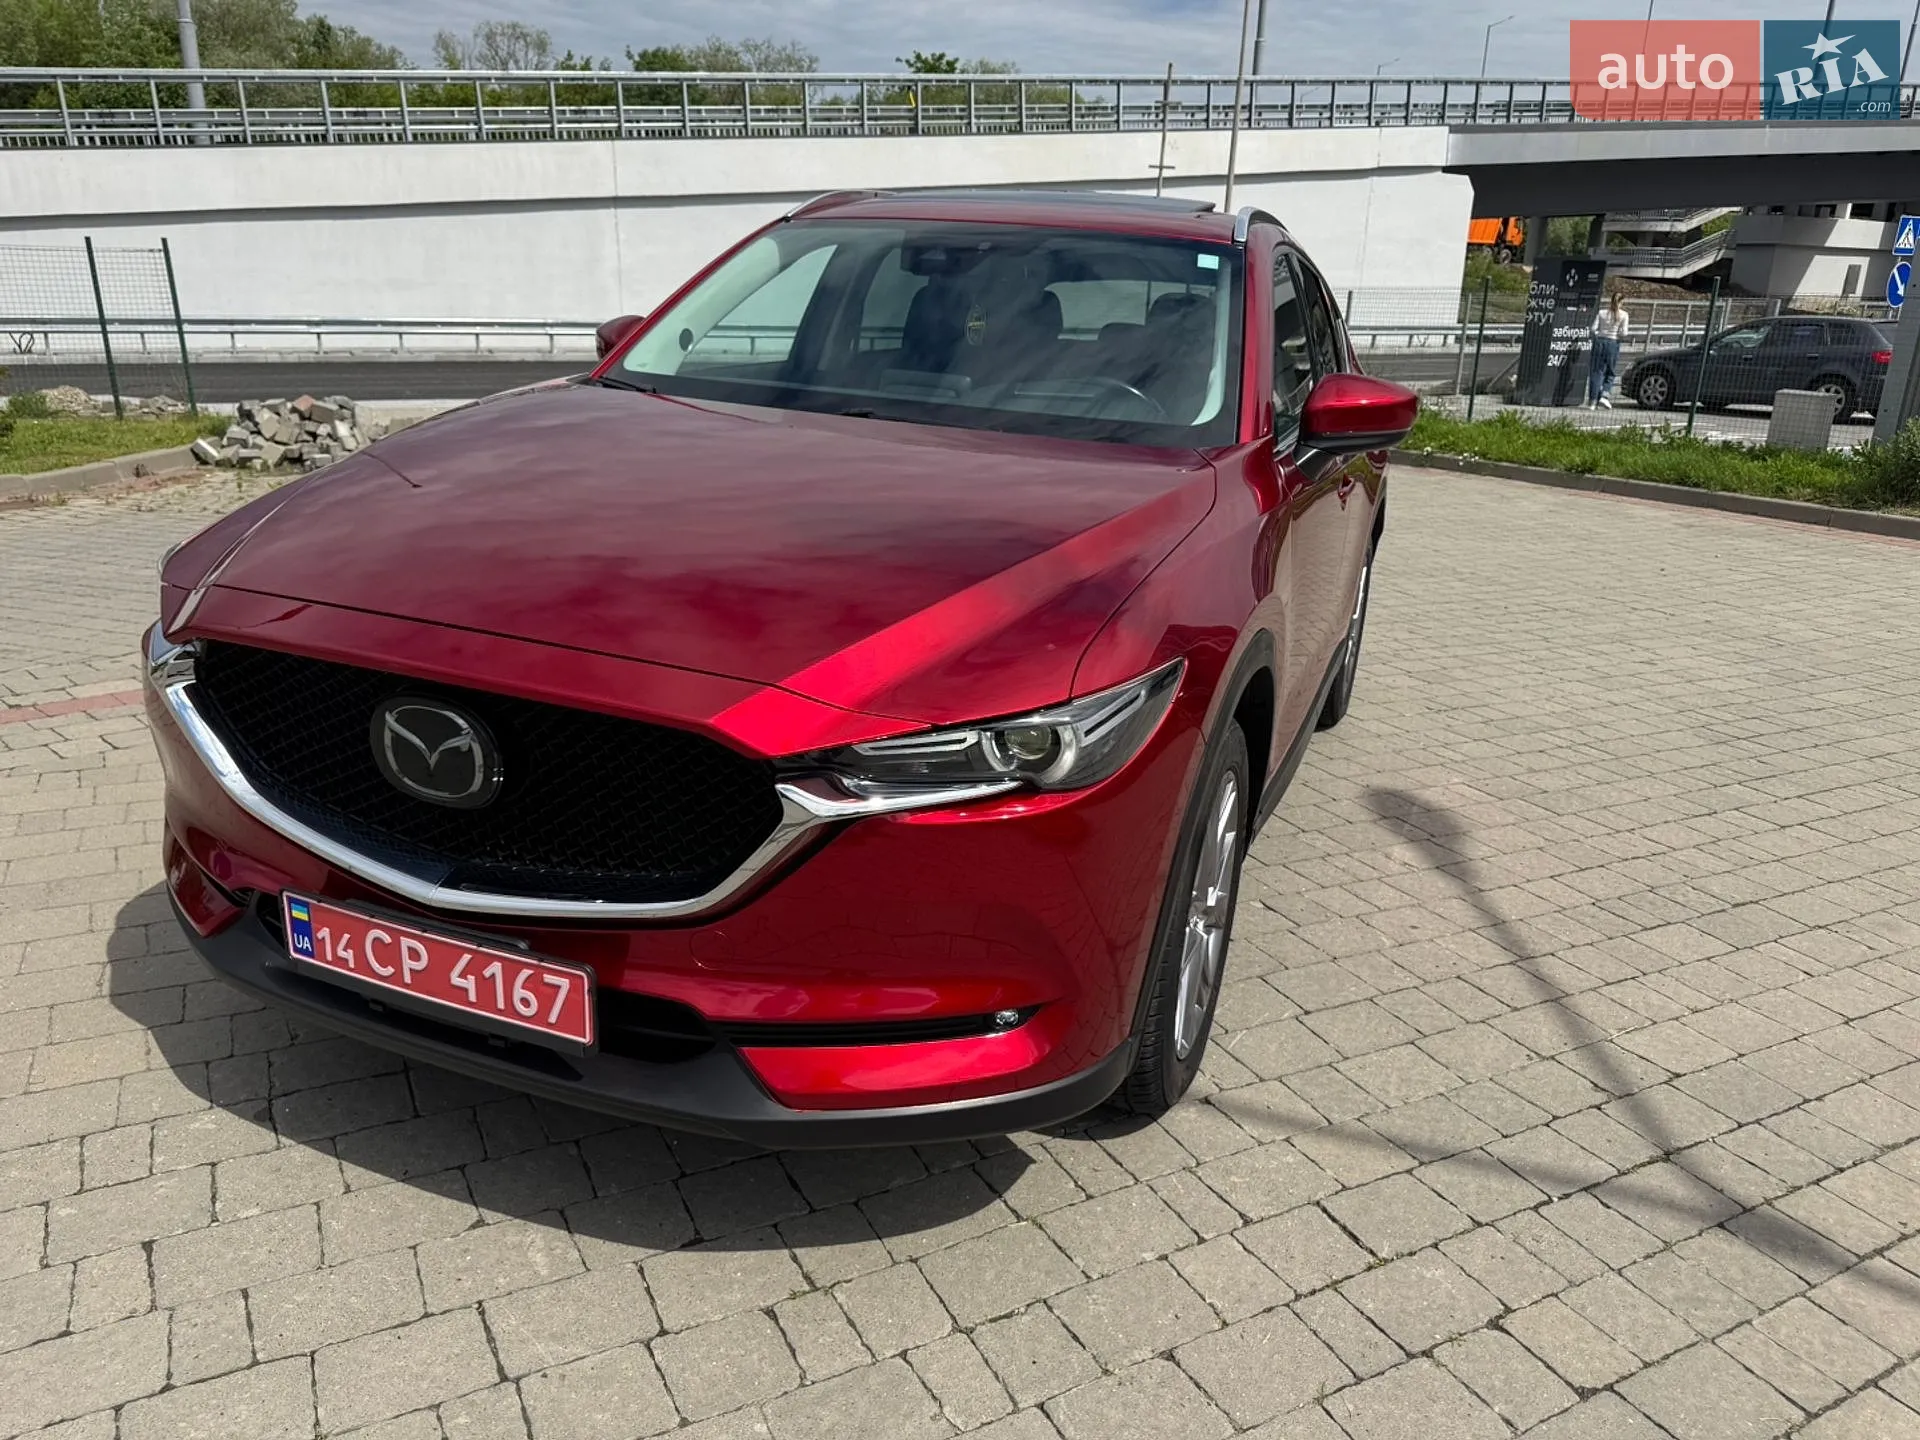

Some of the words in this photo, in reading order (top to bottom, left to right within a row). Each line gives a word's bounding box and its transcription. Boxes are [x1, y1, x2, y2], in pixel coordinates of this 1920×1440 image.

[1547, 354, 1568, 367] 24/7
[294, 934, 312, 951] UA
[316, 927, 354, 968] 14
[365, 929, 429, 984] CP
[450, 953, 570, 1024] 4167
